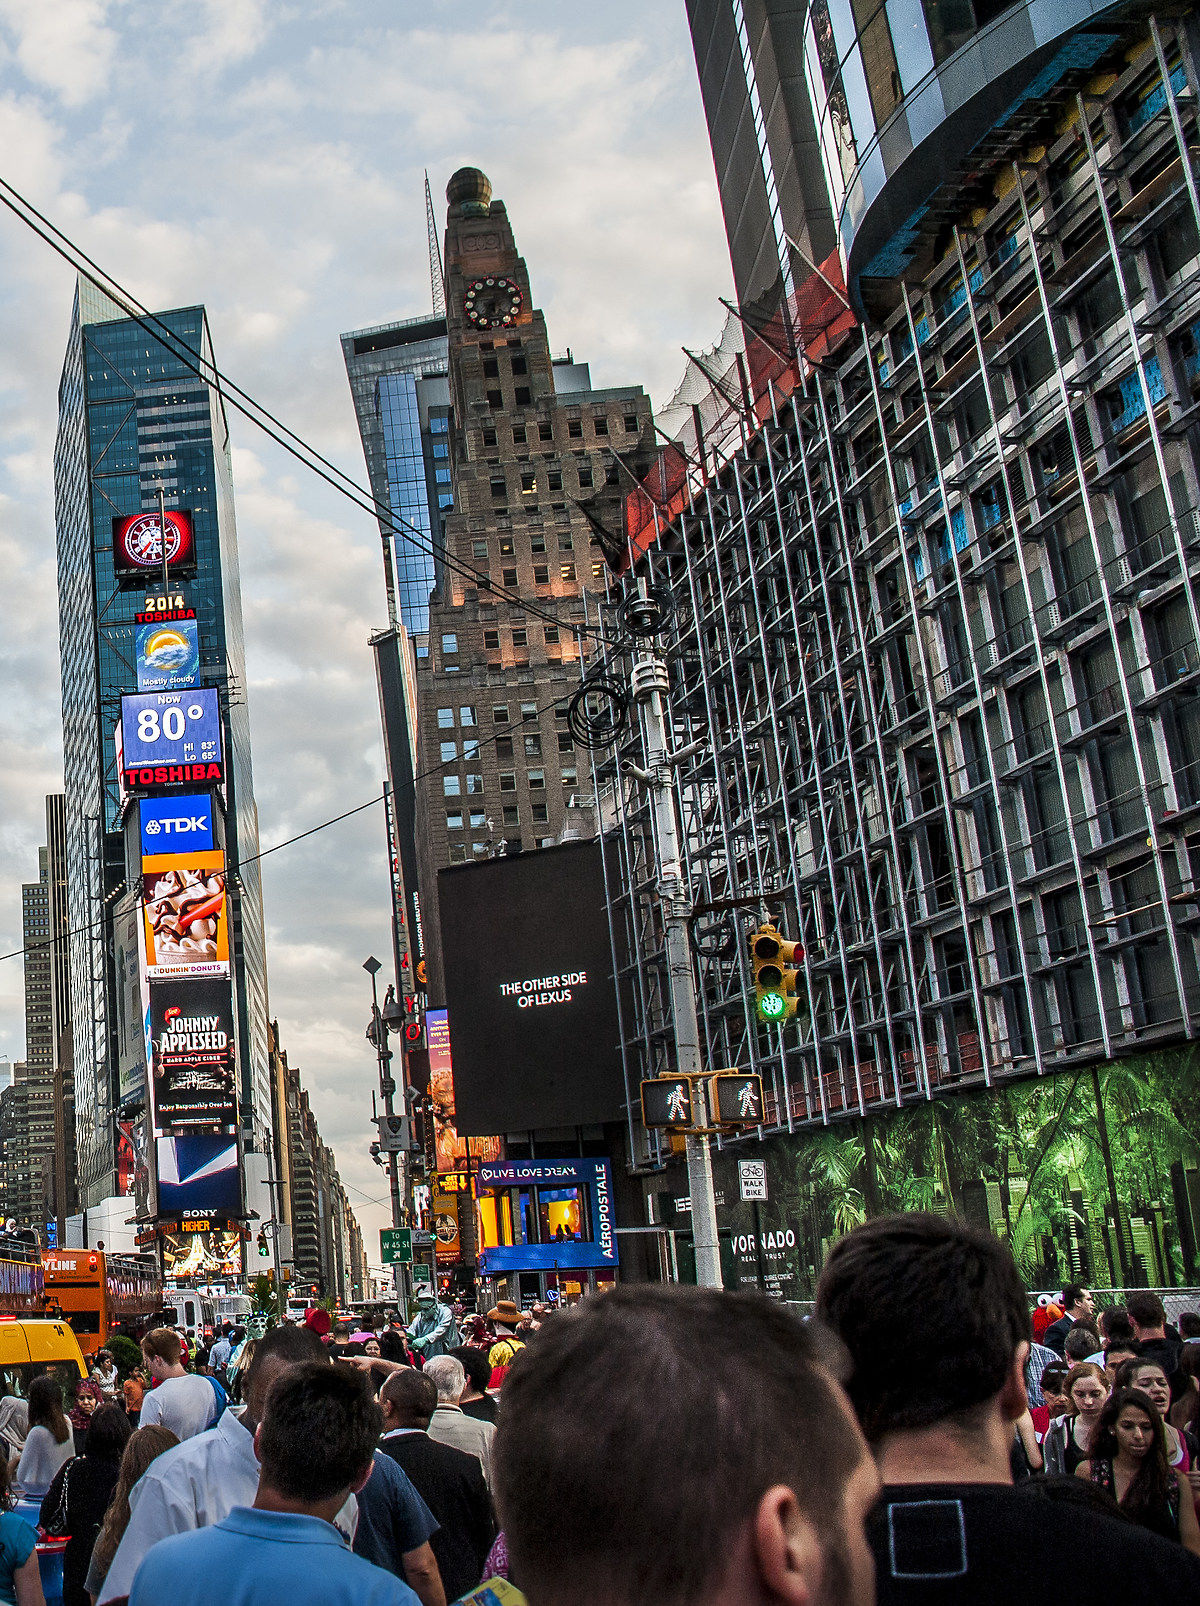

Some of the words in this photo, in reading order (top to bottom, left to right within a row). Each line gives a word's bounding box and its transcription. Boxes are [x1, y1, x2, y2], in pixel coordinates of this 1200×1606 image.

[145, 595, 184, 611] 2014
[136, 609, 195, 623] TOSHIBA
[142, 677, 167, 687] Mostly
[169, 674, 195, 685] cloudy
[157, 695, 181, 705] Now
[125, 763, 221, 785] TOSHIBA
[159, 815, 208, 834] TDK
[412, 891, 422, 922] REUTERS
[416, 925, 426, 958] THOMSON
[159, 965, 191, 974] DUNKIN'
[191, 964, 221, 973] DONUTS
[500, 981, 522, 997] THE
[522, 976, 560, 994] OTHER
[561, 971, 587, 988] SIDE
[517, 994, 535, 1008] OF
[535, 989, 572, 1006] LEXUS
[166, 1015, 220, 1033] JOHNNY
[160, 1031, 228, 1053] APPLESEED
[492, 1168, 515, 1178] LIVE
[517, 1168, 543, 1178] LOVE
[745, 1188, 762, 1196] BIKE
[182, 1209, 218, 1218] SONY
[595, 1163, 615, 1259] AÉROPOSTALE
[181, 1220, 210, 1232] HIGHER
[382, 1241, 390, 1249] W
[391, 1241, 401, 1249] 45
[402, 1240, 410, 1248] St
[765, 1252, 786, 1260] TRUST
[43, 1259, 77, 1271] YLINE
